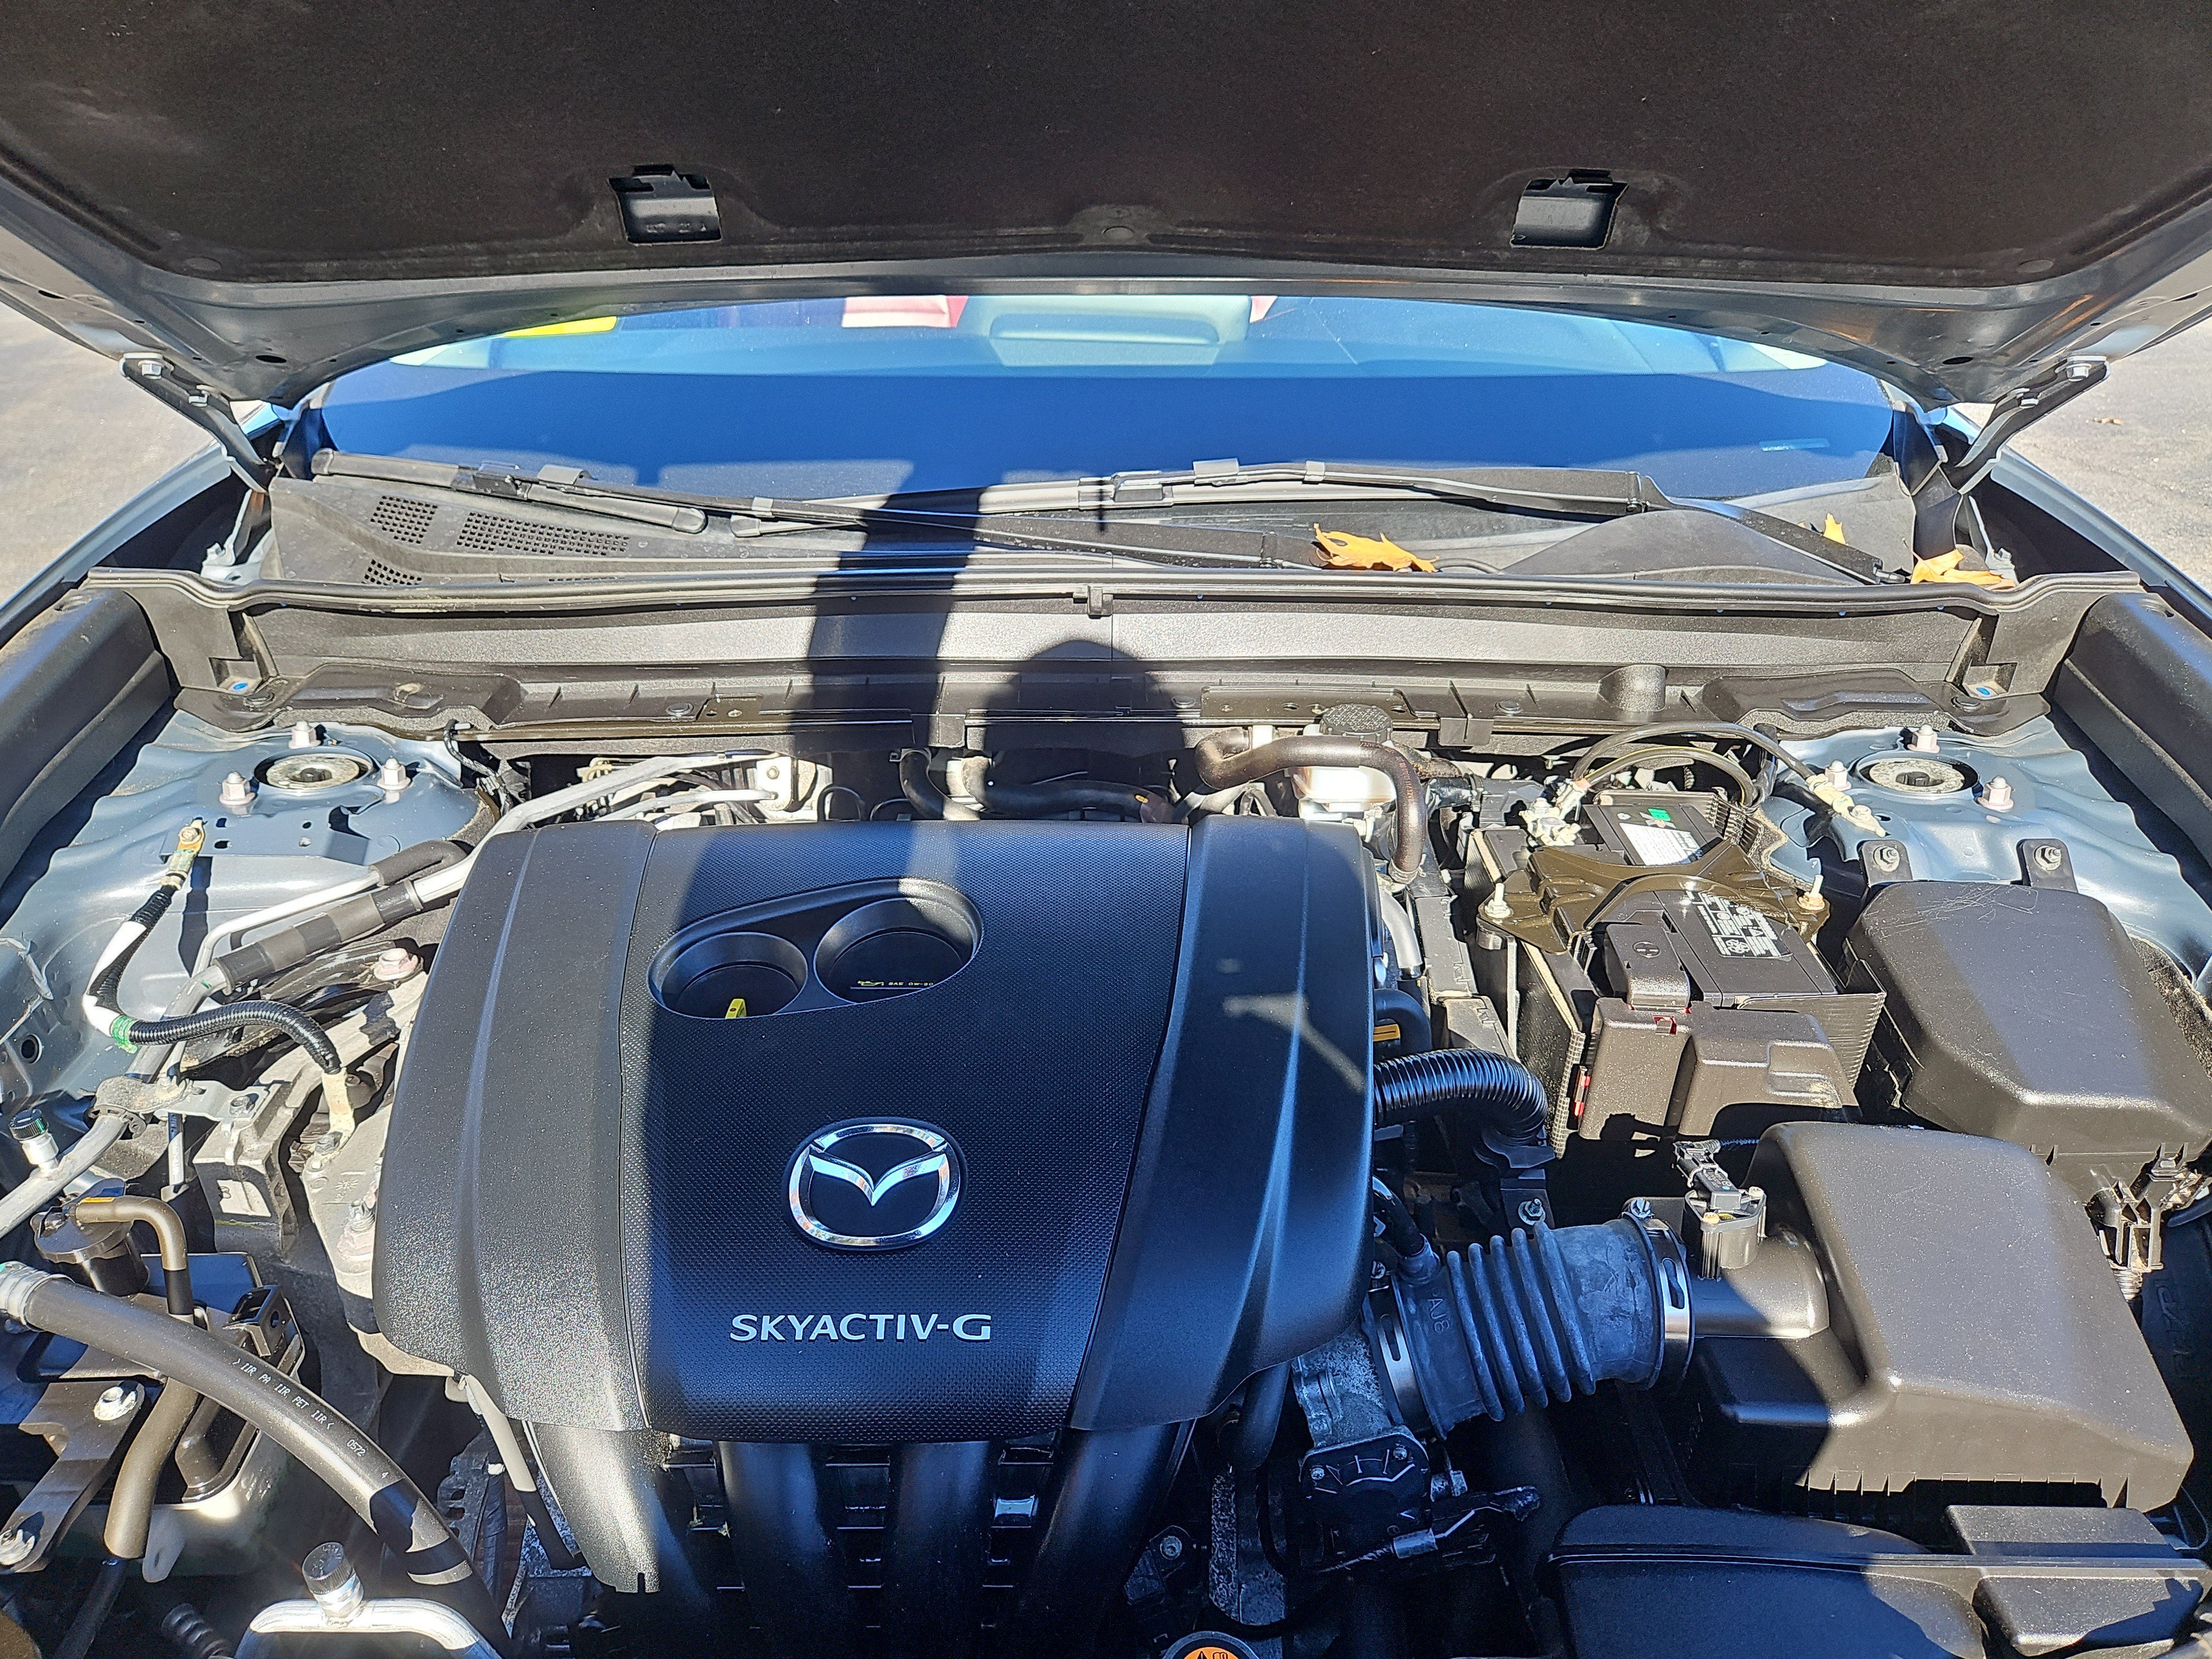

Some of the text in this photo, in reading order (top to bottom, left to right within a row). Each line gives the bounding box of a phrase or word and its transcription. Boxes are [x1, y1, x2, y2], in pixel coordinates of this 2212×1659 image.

[729, 1313, 992, 1341] SKYACTIV-G
[258, 1373, 271, 1384] PA
[292, 1396, 310, 1409] PET
[346, 1439, 366, 1457] 0572
